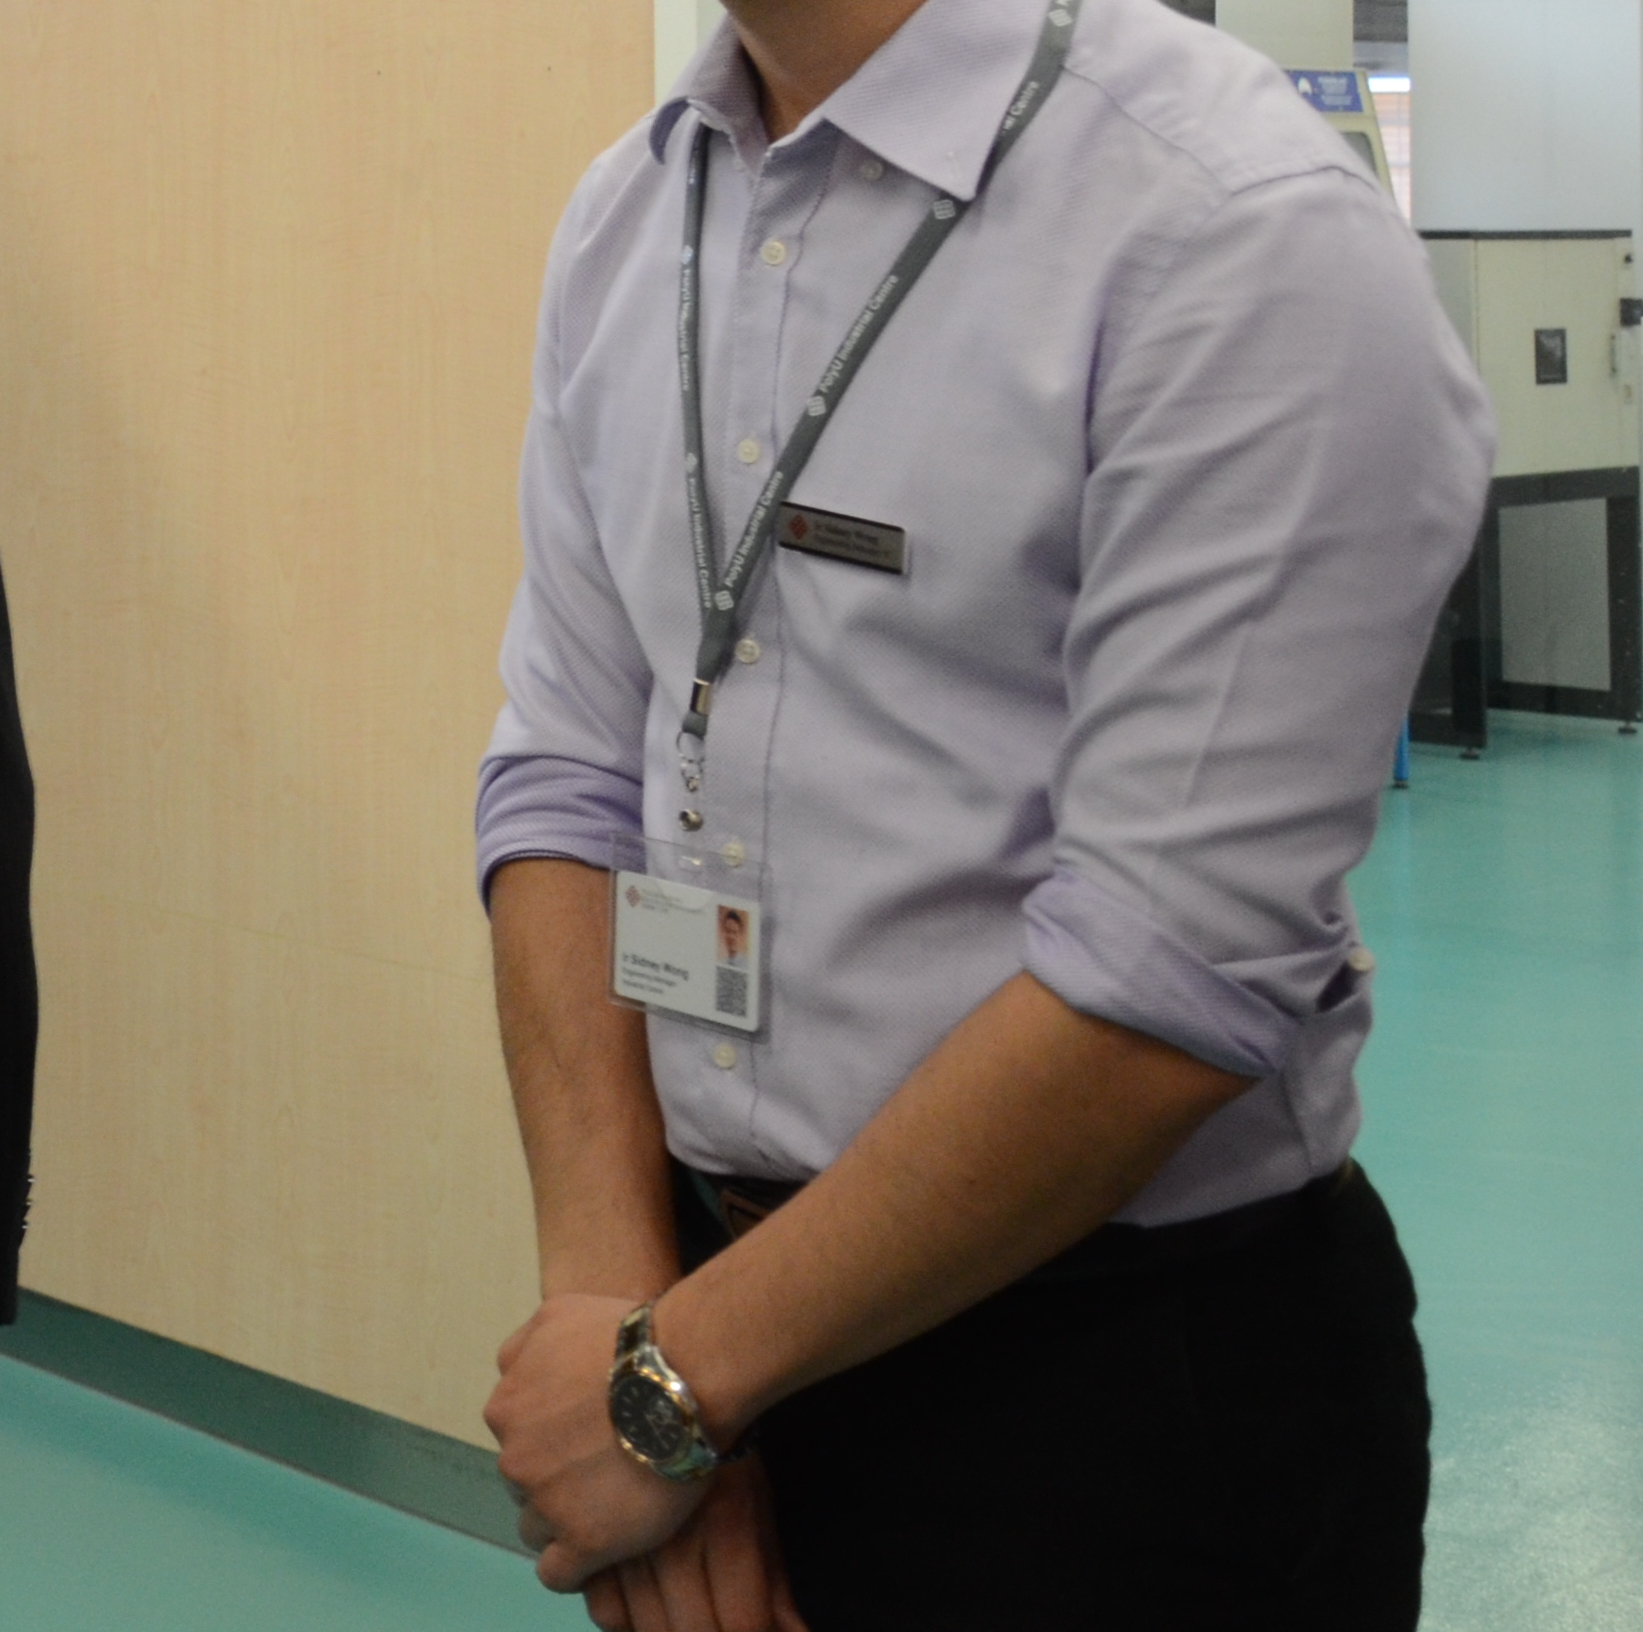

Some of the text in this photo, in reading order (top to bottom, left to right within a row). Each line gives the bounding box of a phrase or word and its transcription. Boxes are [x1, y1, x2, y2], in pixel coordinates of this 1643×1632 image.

[819, 274, 898, 394] PolyU Industrial Centre
[725, 470, 784, 588] PolyU Industrial Centre
